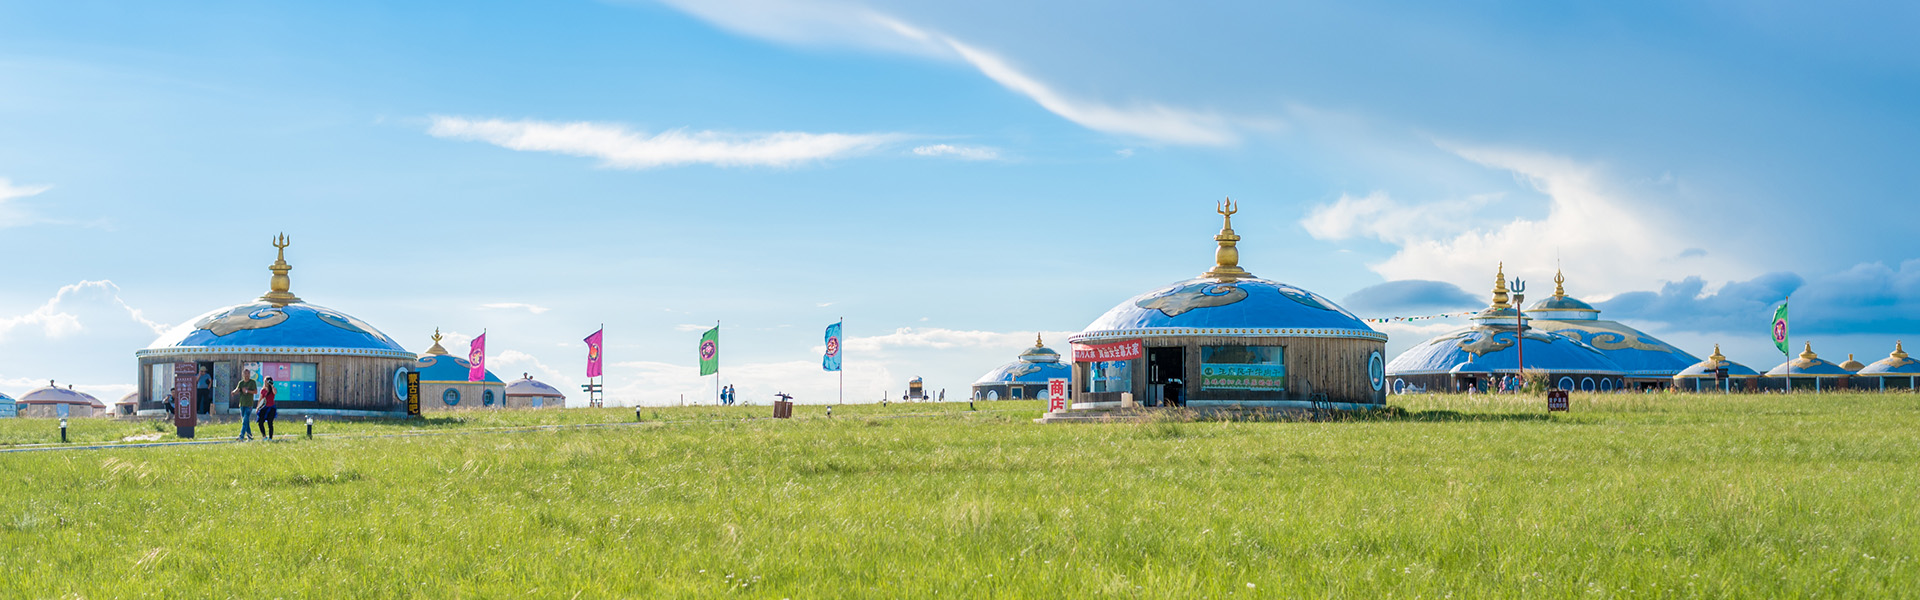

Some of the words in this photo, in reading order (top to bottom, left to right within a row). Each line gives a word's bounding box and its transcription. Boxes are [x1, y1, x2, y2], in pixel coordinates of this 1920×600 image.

[408, 373, 419, 414] 蒙古酒吧
[1049, 379, 1065, 413] 商店
